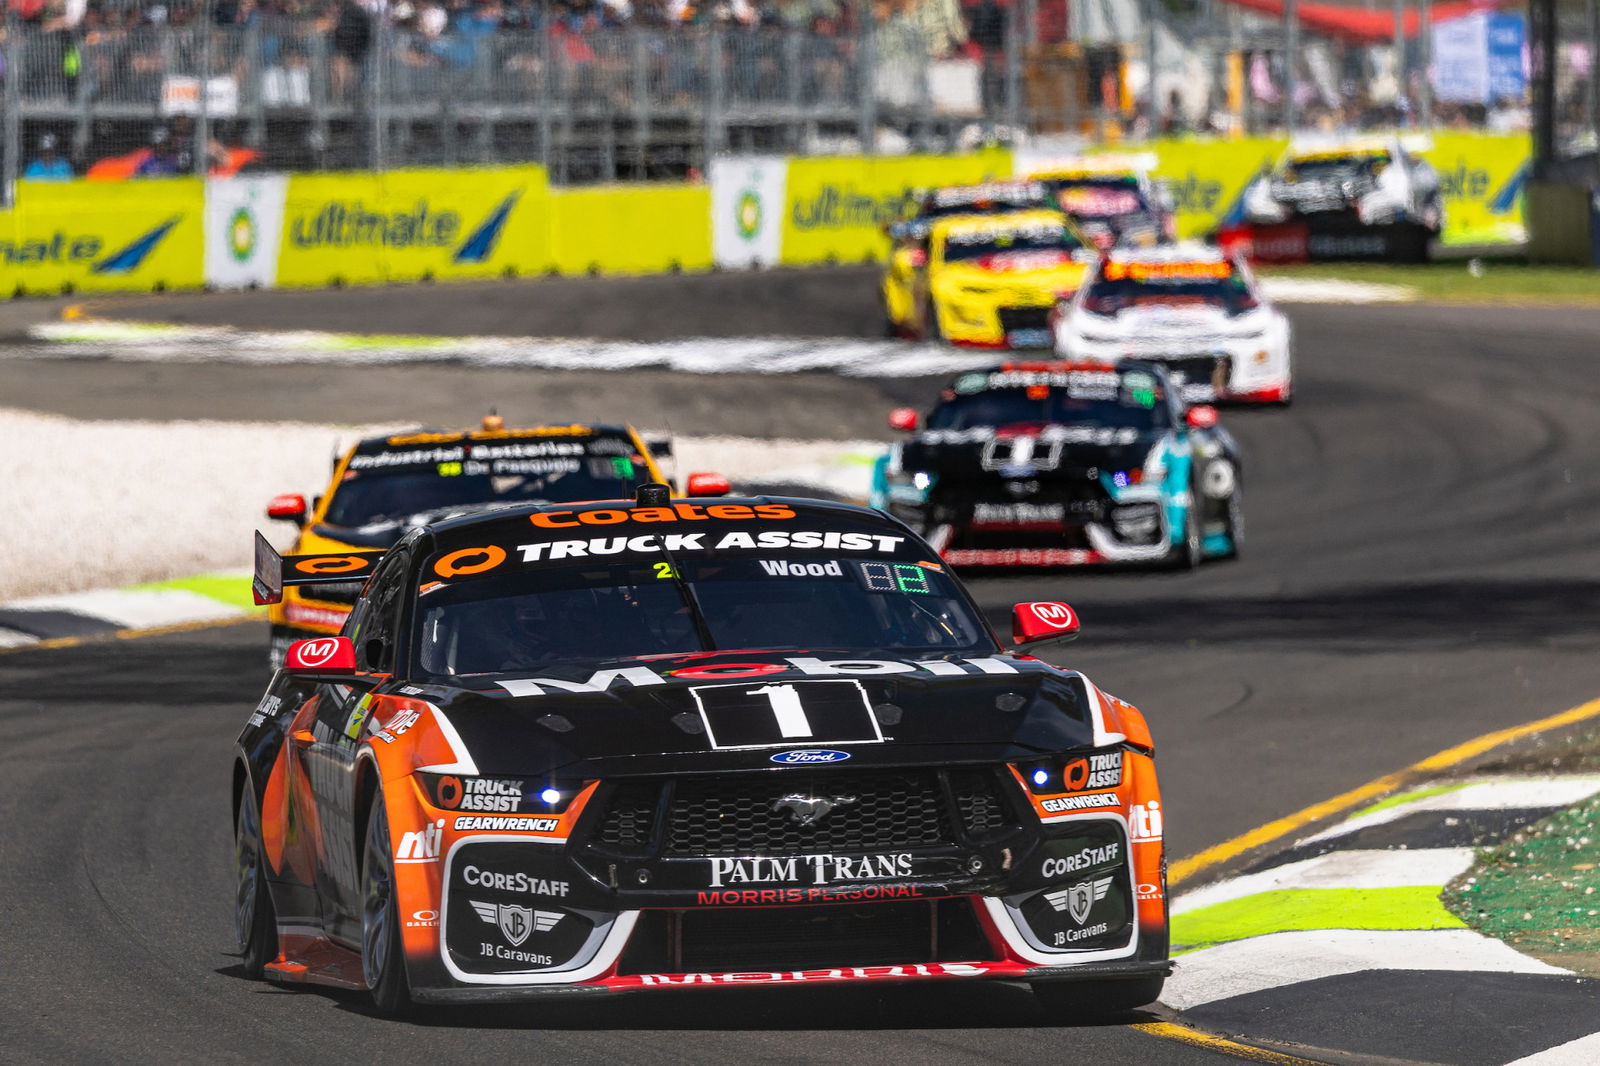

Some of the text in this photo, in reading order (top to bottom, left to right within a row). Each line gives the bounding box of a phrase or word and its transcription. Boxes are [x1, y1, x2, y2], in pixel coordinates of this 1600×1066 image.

[290, 200, 460, 247] ultimate
[529, 504, 796, 528] coates
[517, 531, 905, 563] TRUCK ASSIST
[653, 562, 673, 579] 2
[759, 560, 843, 577] Wood
[493, 656, 1020, 698] Mobil
[746, 684, 813, 738] 1
[786, 750, 836, 763] Ford
[464, 778, 524, 797] TRUCK
[460, 794, 522, 812] ASSIST
[1041, 793, 1121, 812] GEARWRENCH
[453, 816, 559, 832] GEARWRENCH
[708, 853, 913, 888] PALM TRANS
[698, 887, 803, 905] MORRIS
[1053, 922, 1107, 946] JB Caravans
[480, 942, 553, 966] JB Caravans
